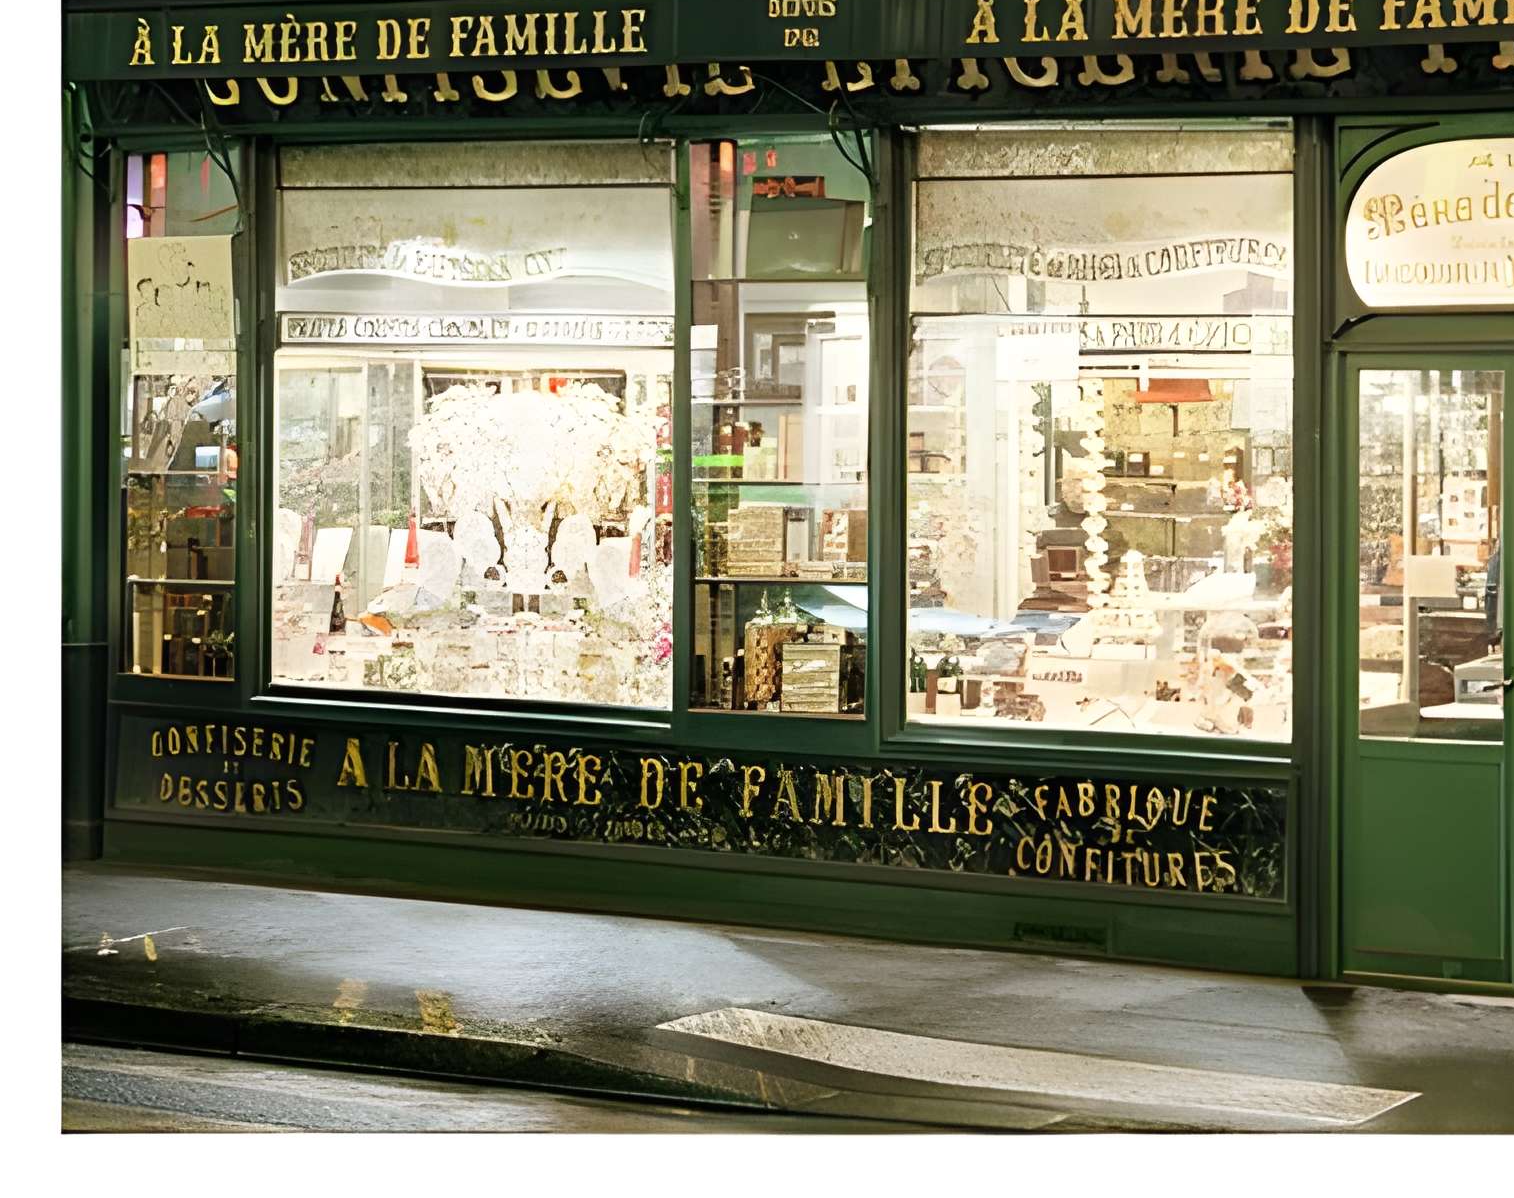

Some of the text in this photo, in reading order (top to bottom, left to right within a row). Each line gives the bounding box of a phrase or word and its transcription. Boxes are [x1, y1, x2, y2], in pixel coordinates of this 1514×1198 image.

[129, 9, 648, 65] À LA MÈRE DE FAMILLE
[337, 737, 368, 788] A
[384, 741, 442, 792] LA
[640, 757, 703, 810] DE
[738, 764, 994, 836] FAMILLE
